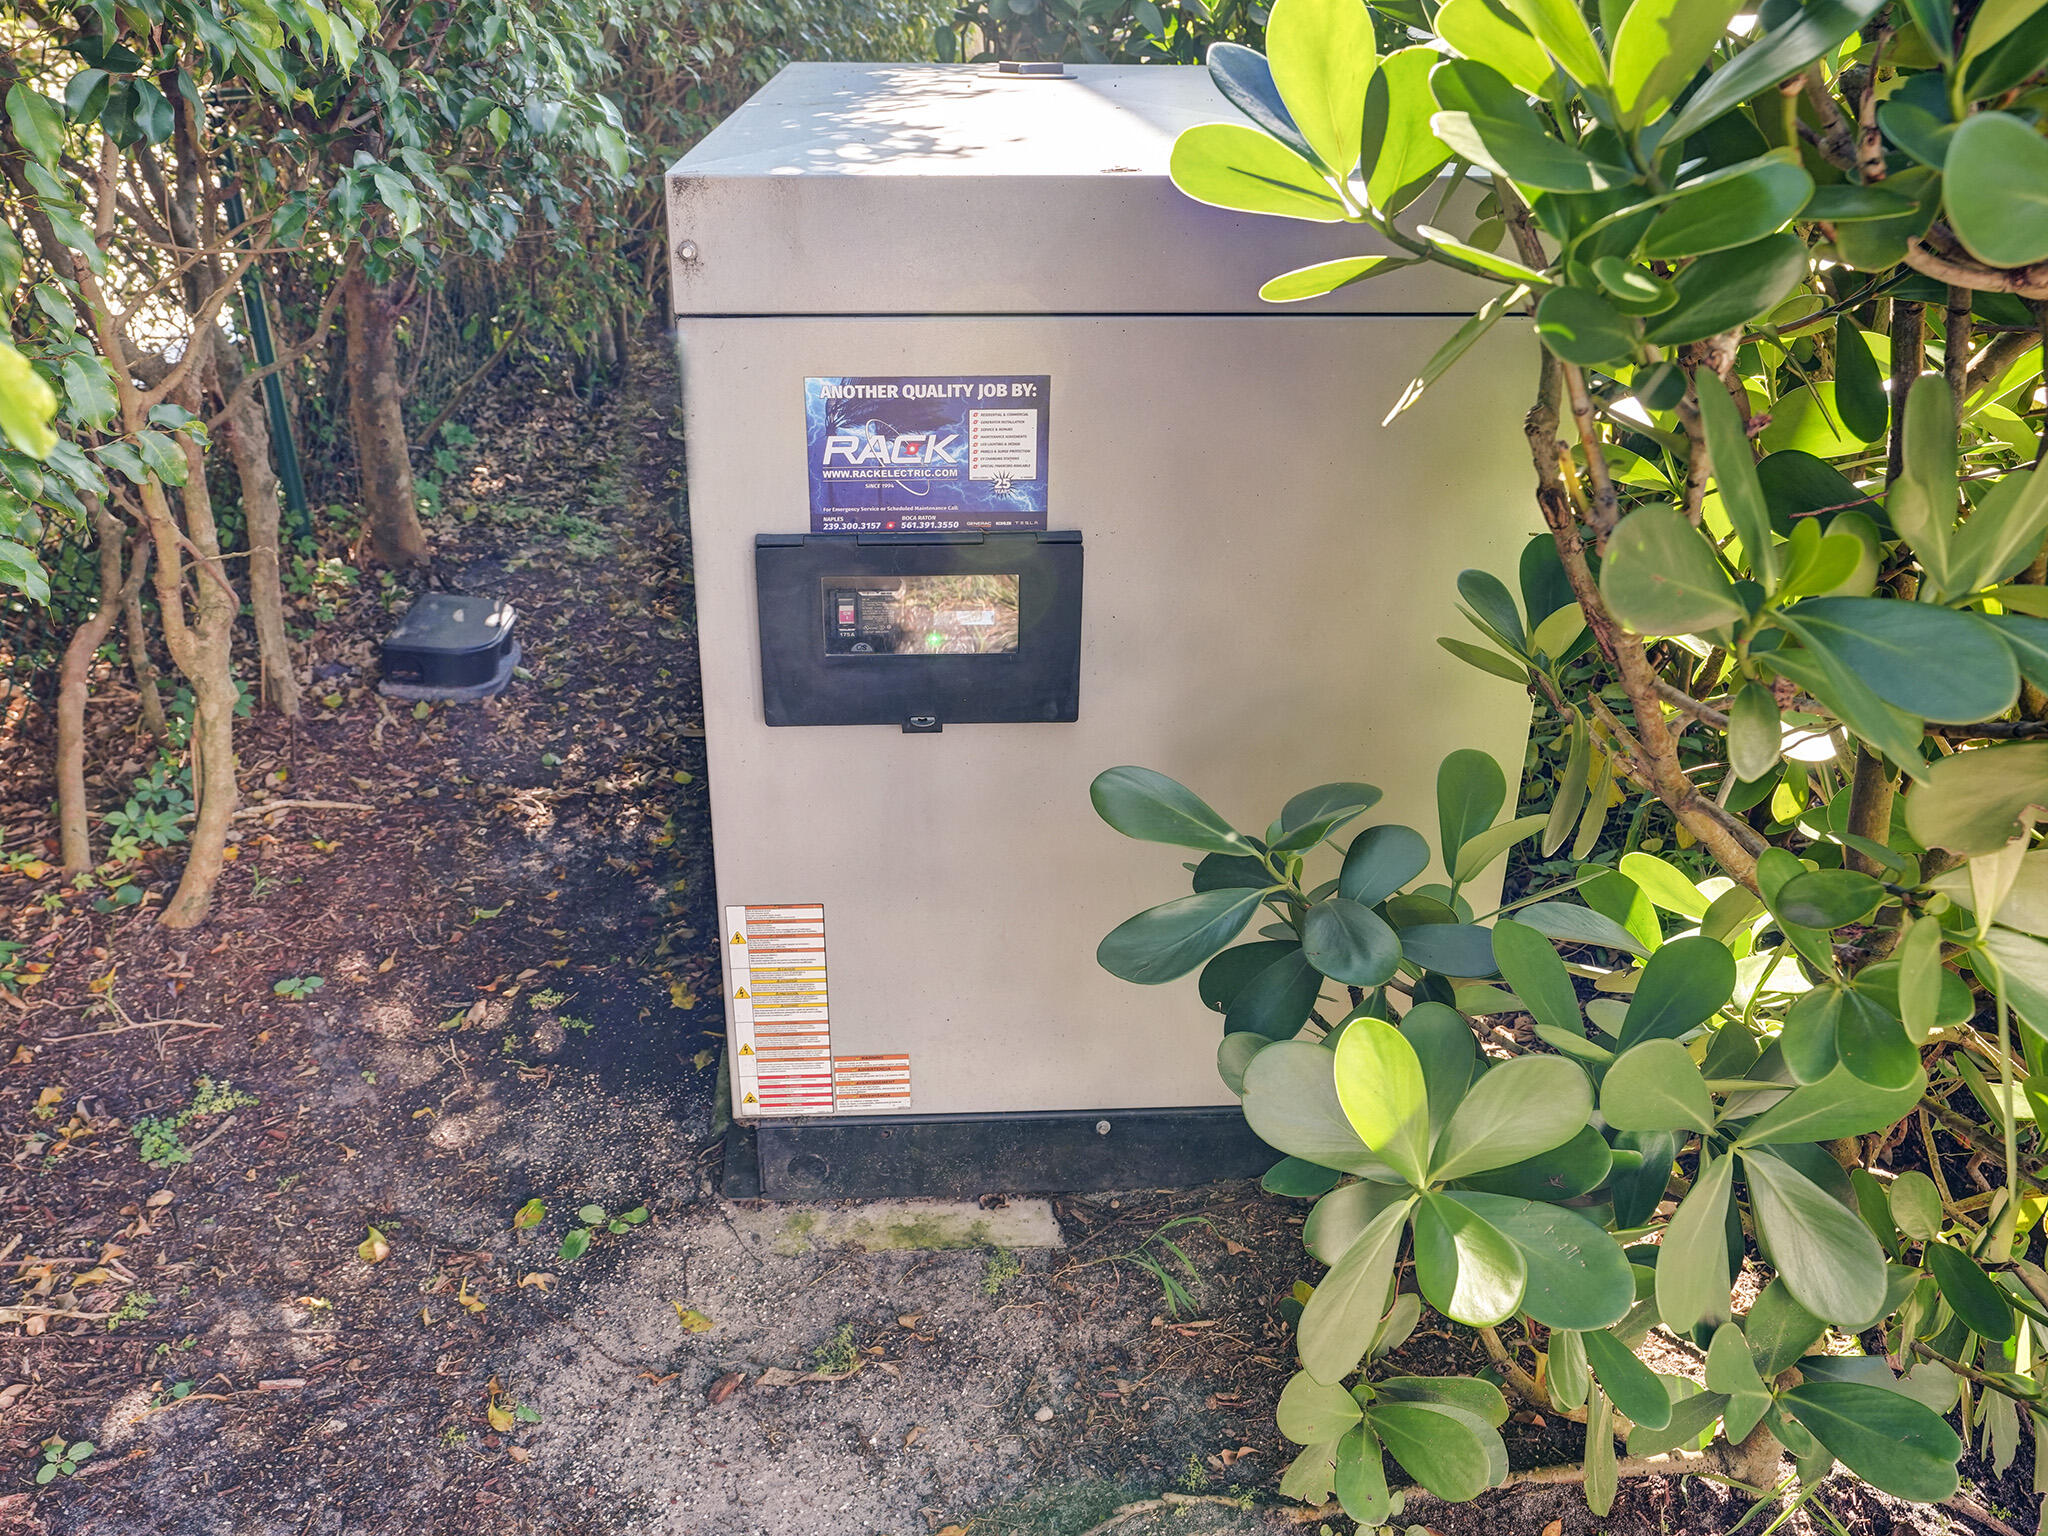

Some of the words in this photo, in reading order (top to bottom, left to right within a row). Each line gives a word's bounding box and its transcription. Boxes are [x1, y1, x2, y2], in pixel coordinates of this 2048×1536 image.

[820, 384, 898, 399] ANOTHER
[902, 384, 974, 400] QUALITY
[977, 384, 1007, 400] JOB
[1011, 383, 1037, 397] BY:
[823, 434, 960, 465] RACK
[822, 468, 958, 479] WWW.RACKELECTRIC.COM
[994, 478, 1011, 489] 25
[823, 522, 881, 530] 239.300.3157
[901, 521, 959, 529] 561.391.3550
